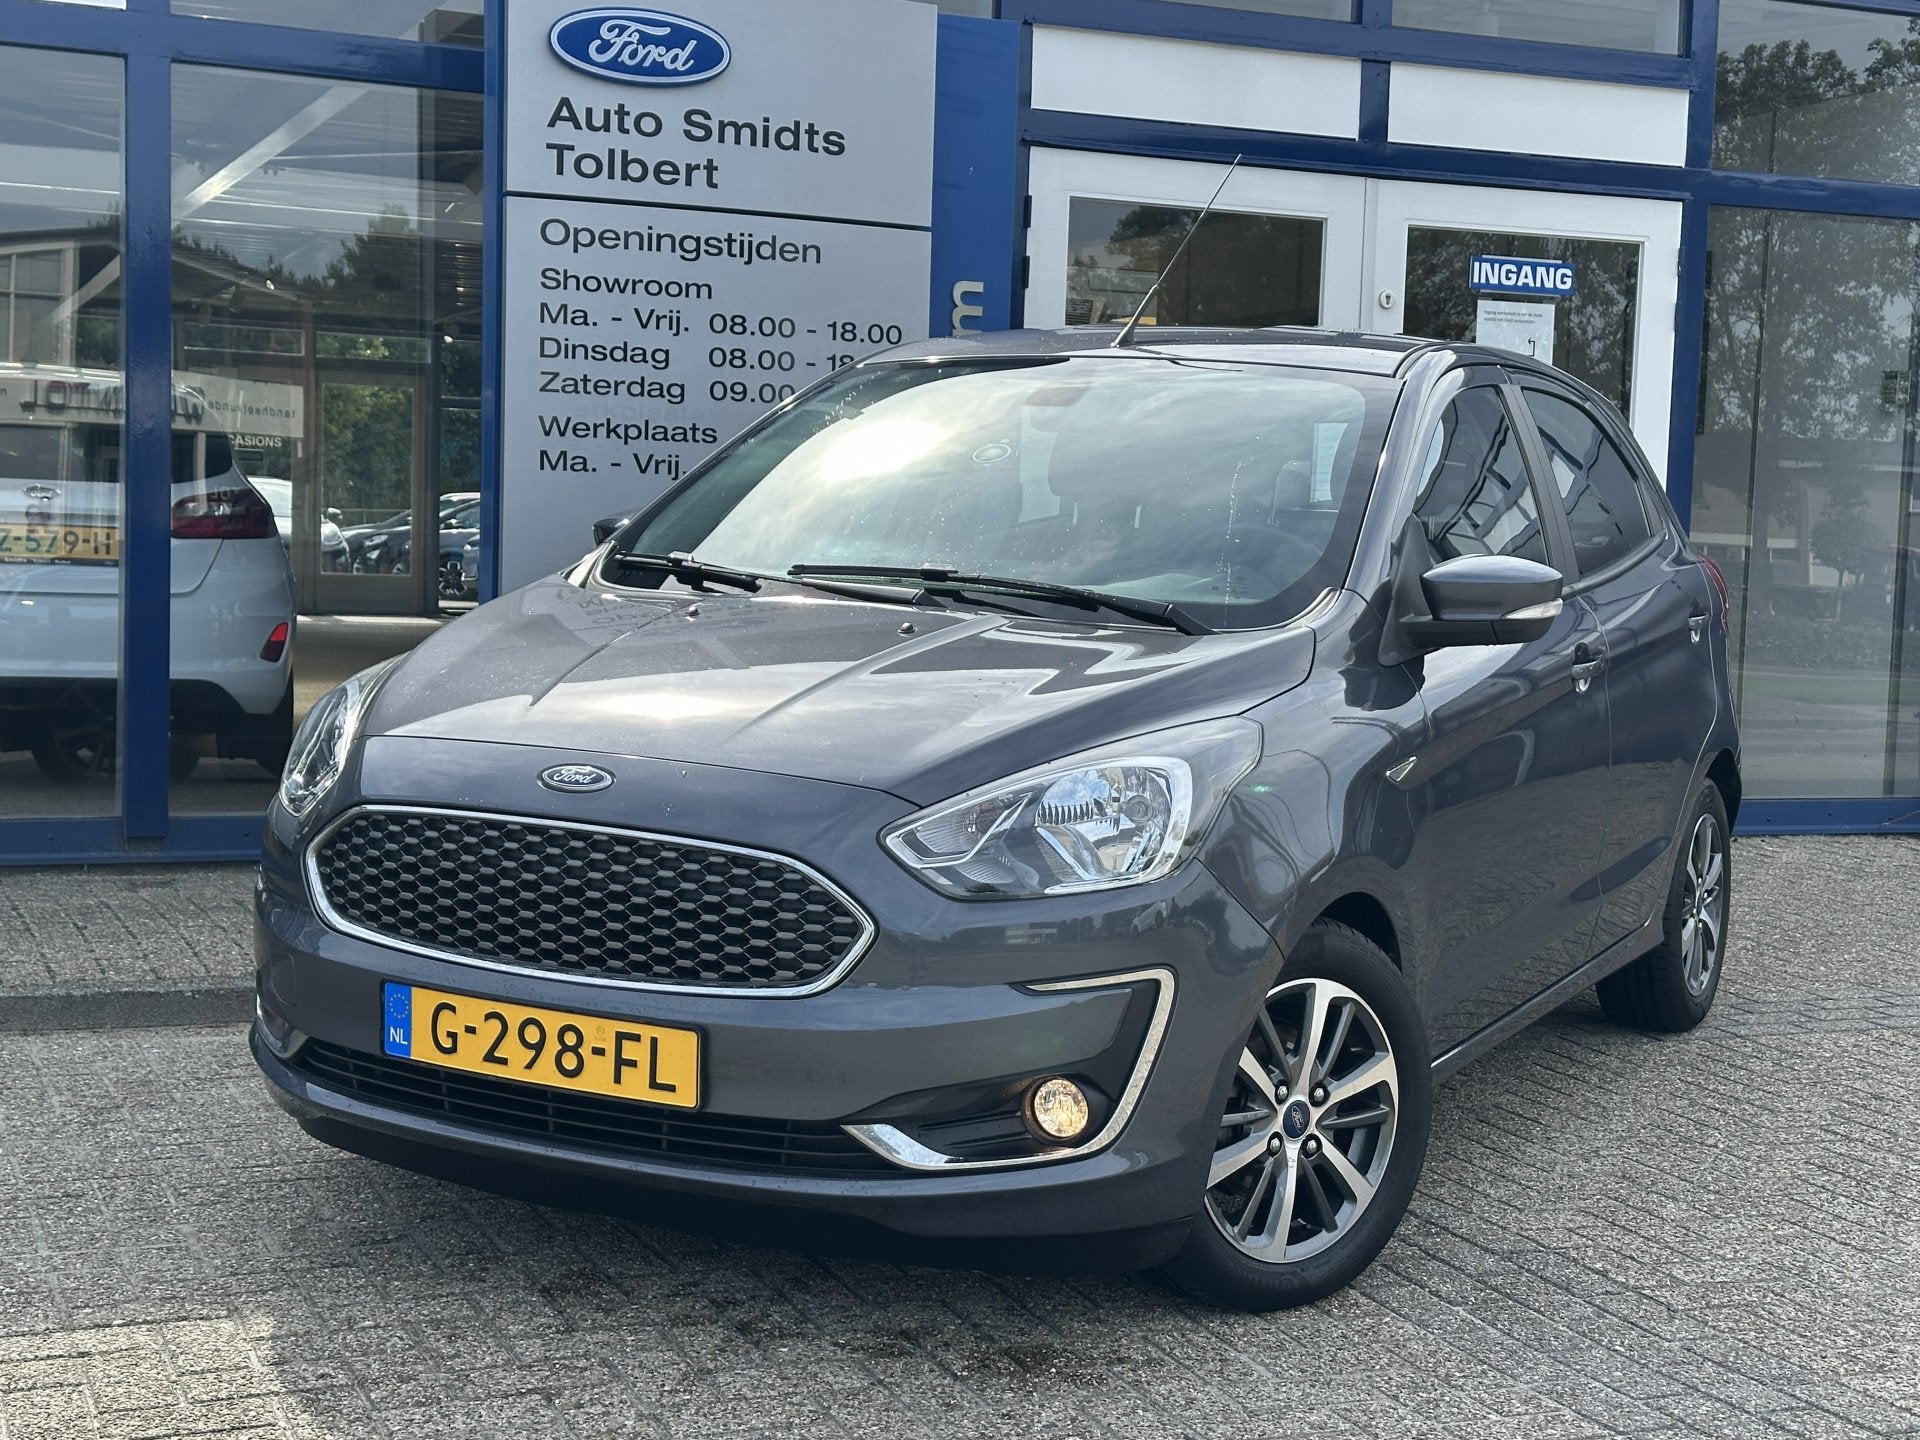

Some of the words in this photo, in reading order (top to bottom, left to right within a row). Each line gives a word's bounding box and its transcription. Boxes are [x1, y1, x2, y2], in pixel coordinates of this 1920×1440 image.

[588, 19, 696, 71] Ford
[546, 96, 663, 138] Auto
[683, 108, 846, 156] Smidts
[546, 142, 719, 189] Tolbert
[540, 217, 822, 265] Openingstijden
[540, 267, 713, 300] Showroom
[1473, 261, 1573, 290] INGANG
[539, 302, 598, 327] Ma.
[633, 307, 690, 335] Vrij.
[709, 312, 796, 338] 08.00
[826, 320, 903, 345] 18.00
[539, 336, 671, 370] Dinsdag
[708, 346, 795, 371] 08.00
[539, 371, 686, 405] Zaterdag
[538, 415, 718, 446] Werkplaats
[538, 449, 597, 474] Ma.
[553, 768, 597, 784] Ford
[389, 1027, 408, 1045] NL
[431, 1001, 676, 1093] G-298-FL
